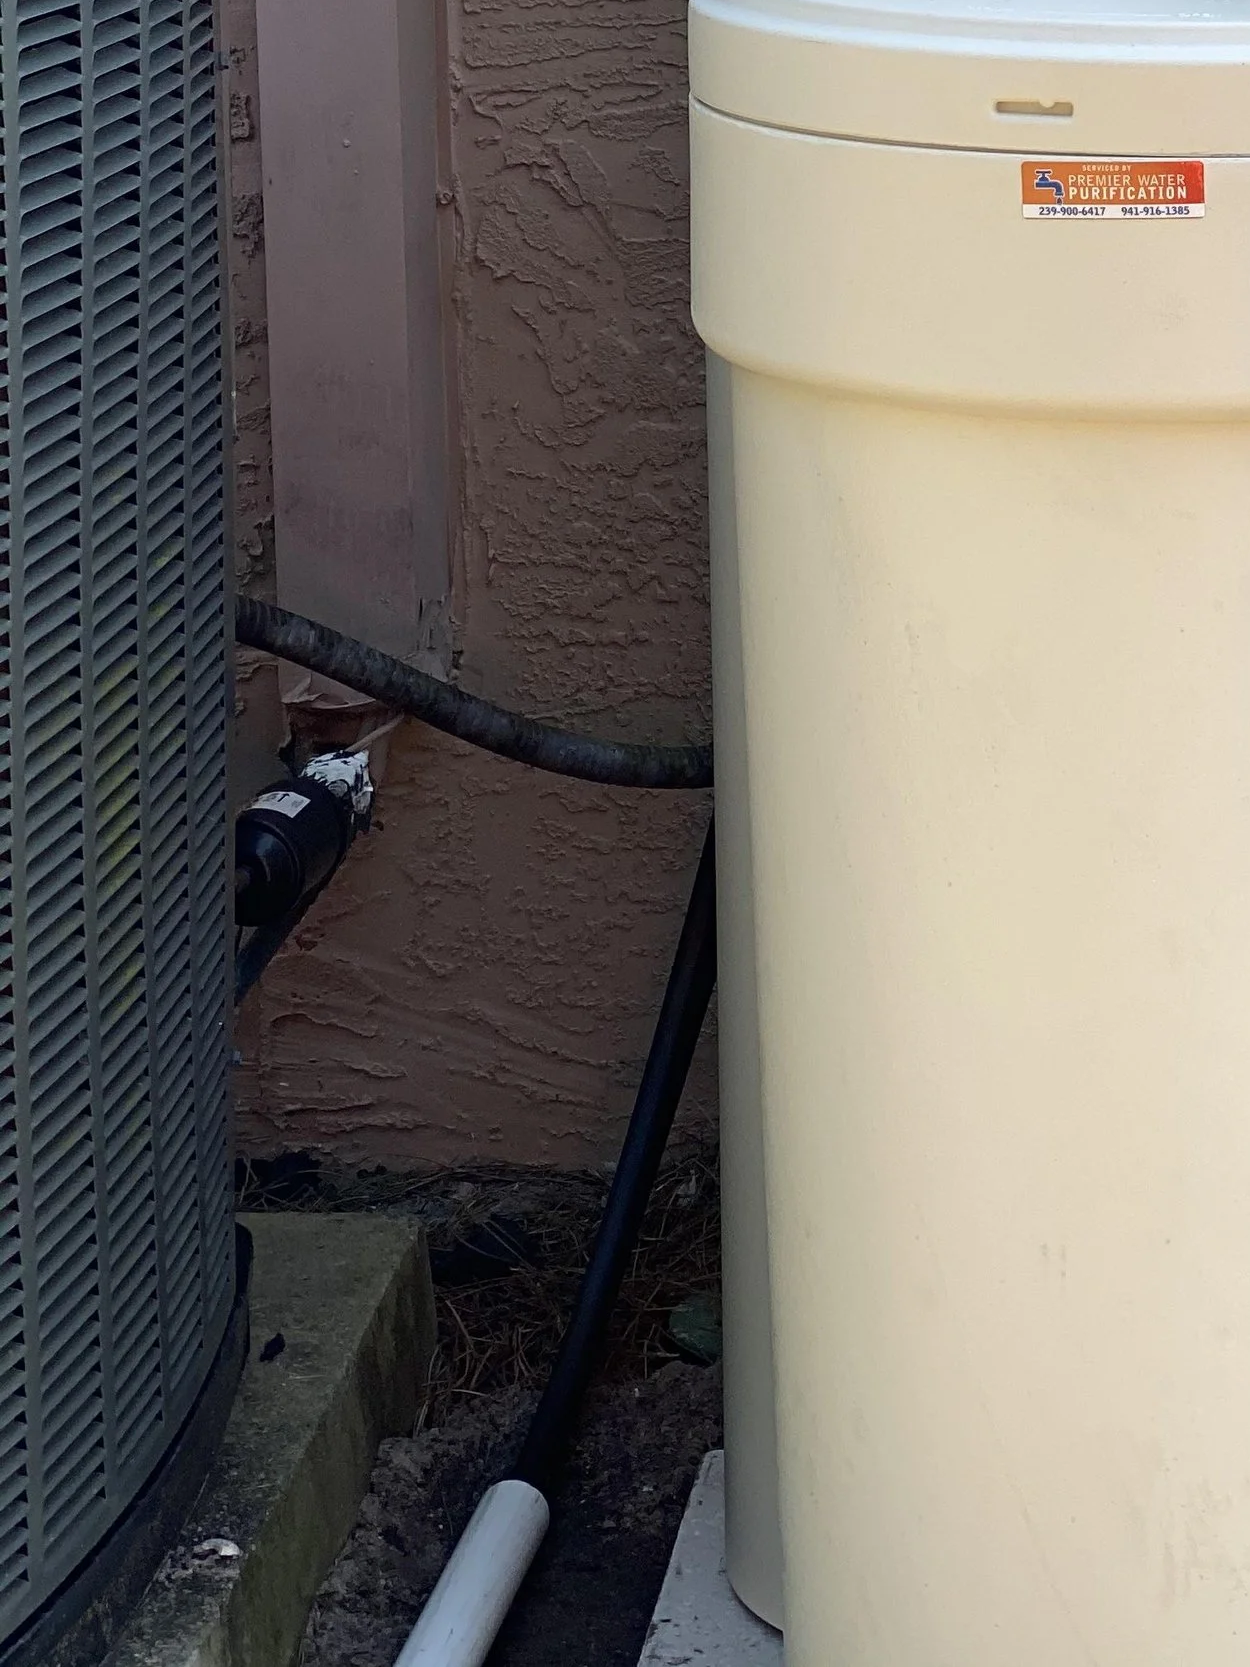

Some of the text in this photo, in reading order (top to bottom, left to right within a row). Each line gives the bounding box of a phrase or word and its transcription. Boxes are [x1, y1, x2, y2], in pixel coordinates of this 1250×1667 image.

[1082, 164, 1119, 172] SERVICED
[1068, 174, 1185, 186] PREMIER WATER
[1068, 186, 1187, 200] PURIFICATION
[1038, 205, 1190, 216] 239-900-6417 941-916-1385
